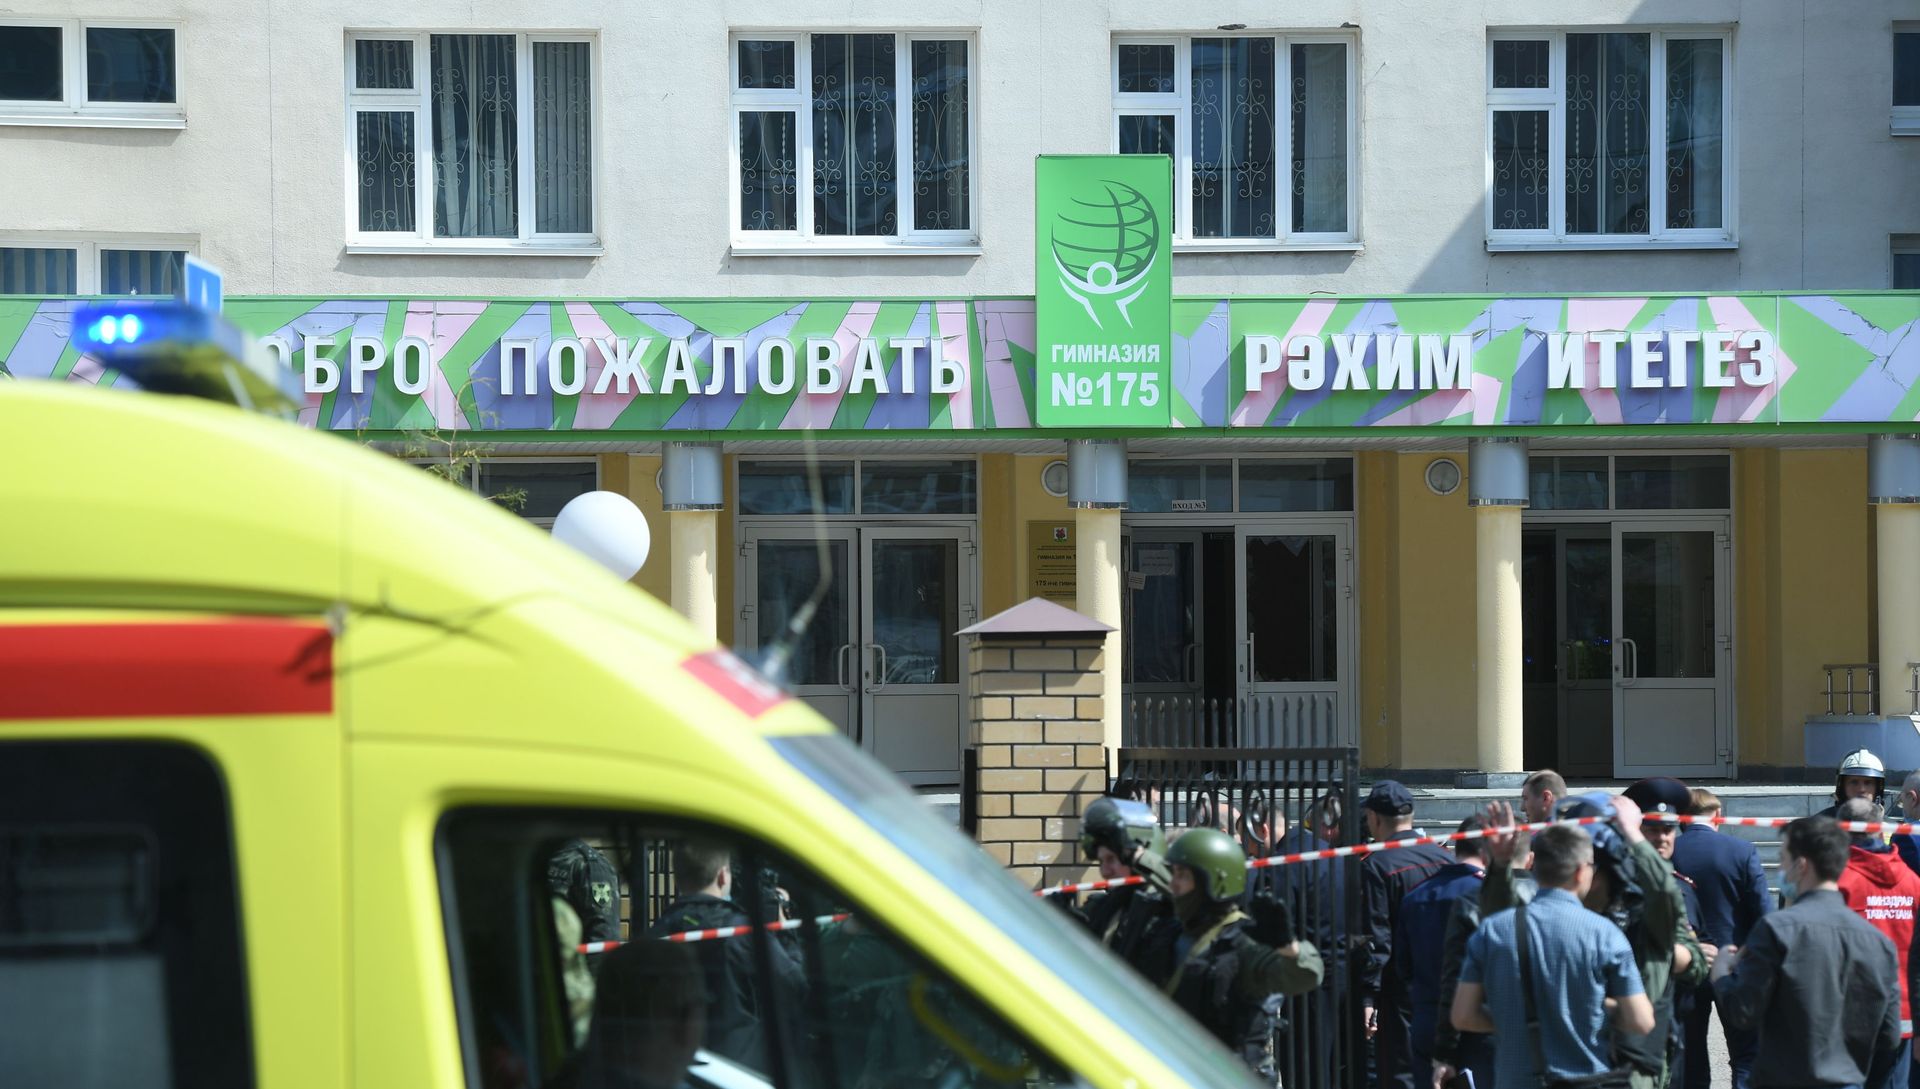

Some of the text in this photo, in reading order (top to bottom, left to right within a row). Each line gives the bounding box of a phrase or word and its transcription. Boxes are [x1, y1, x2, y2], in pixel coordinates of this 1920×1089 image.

[258, 335, 966, 396] ОБРО ПОЖАЛОВАТЬ
[1051, 344, 1160, 363] ГИМНАЗИЯ
[1244, 330, 1777, 392] РӘХИМ ИТЕГЕЗ
[1051, 371, 1160, 407] №175
[1867, 895, 1913, 908] МИНЗДРАВ
